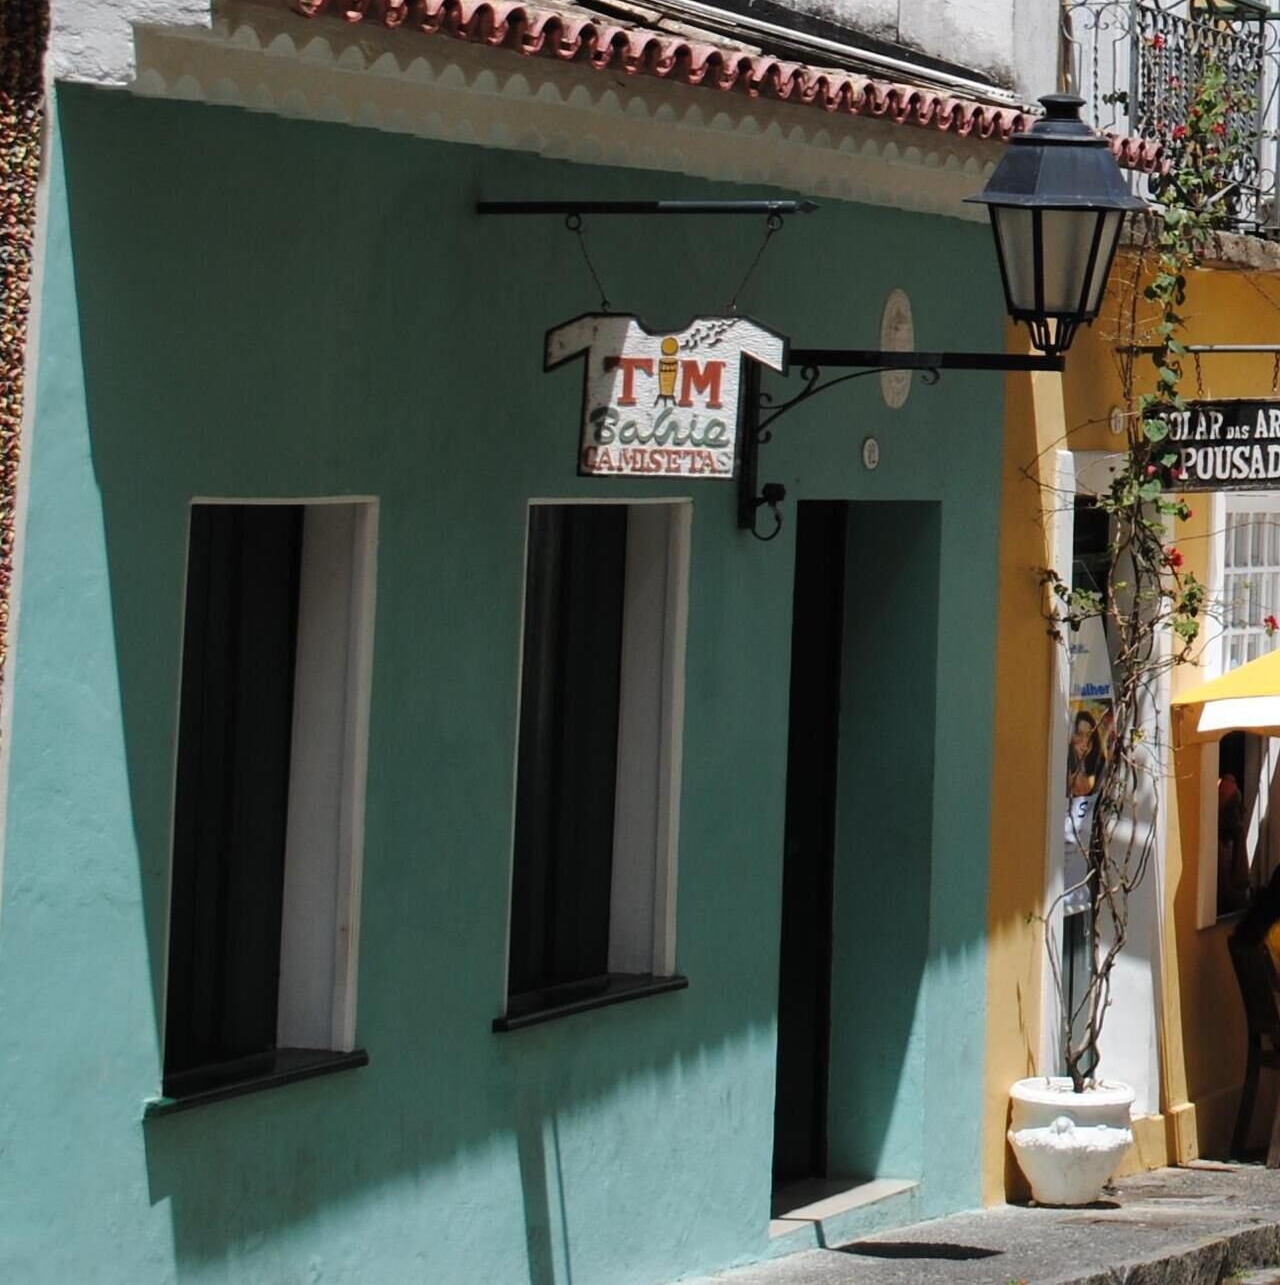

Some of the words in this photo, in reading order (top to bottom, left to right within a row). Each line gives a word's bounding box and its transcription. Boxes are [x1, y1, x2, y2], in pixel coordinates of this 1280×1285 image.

[1160, 411, 1224, 441] OLAR
[1226, 426, 1250, 440] DAS
[583, 446, 733, 474] CAMISETAS
